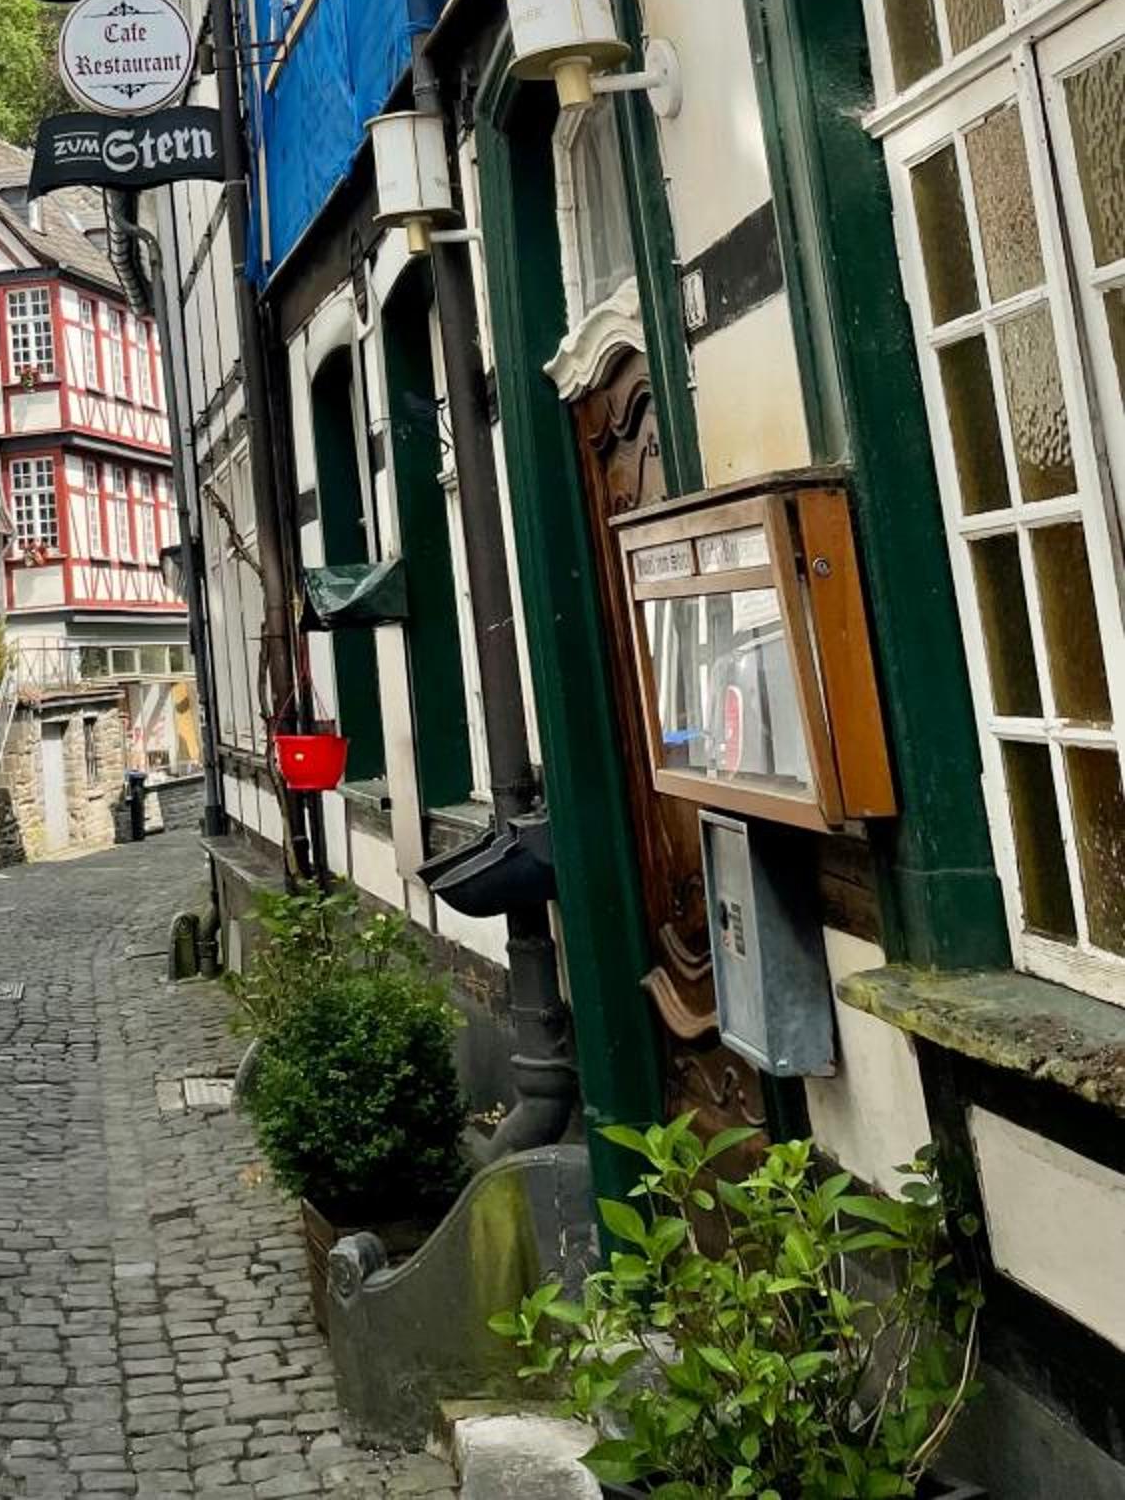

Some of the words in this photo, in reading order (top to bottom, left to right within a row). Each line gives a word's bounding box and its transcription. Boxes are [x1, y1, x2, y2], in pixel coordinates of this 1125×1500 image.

[104, 22, 147, 43] Cafe
[75, 52, 182, 76] Restaurant
[102, 127, 217, 173] Stern
